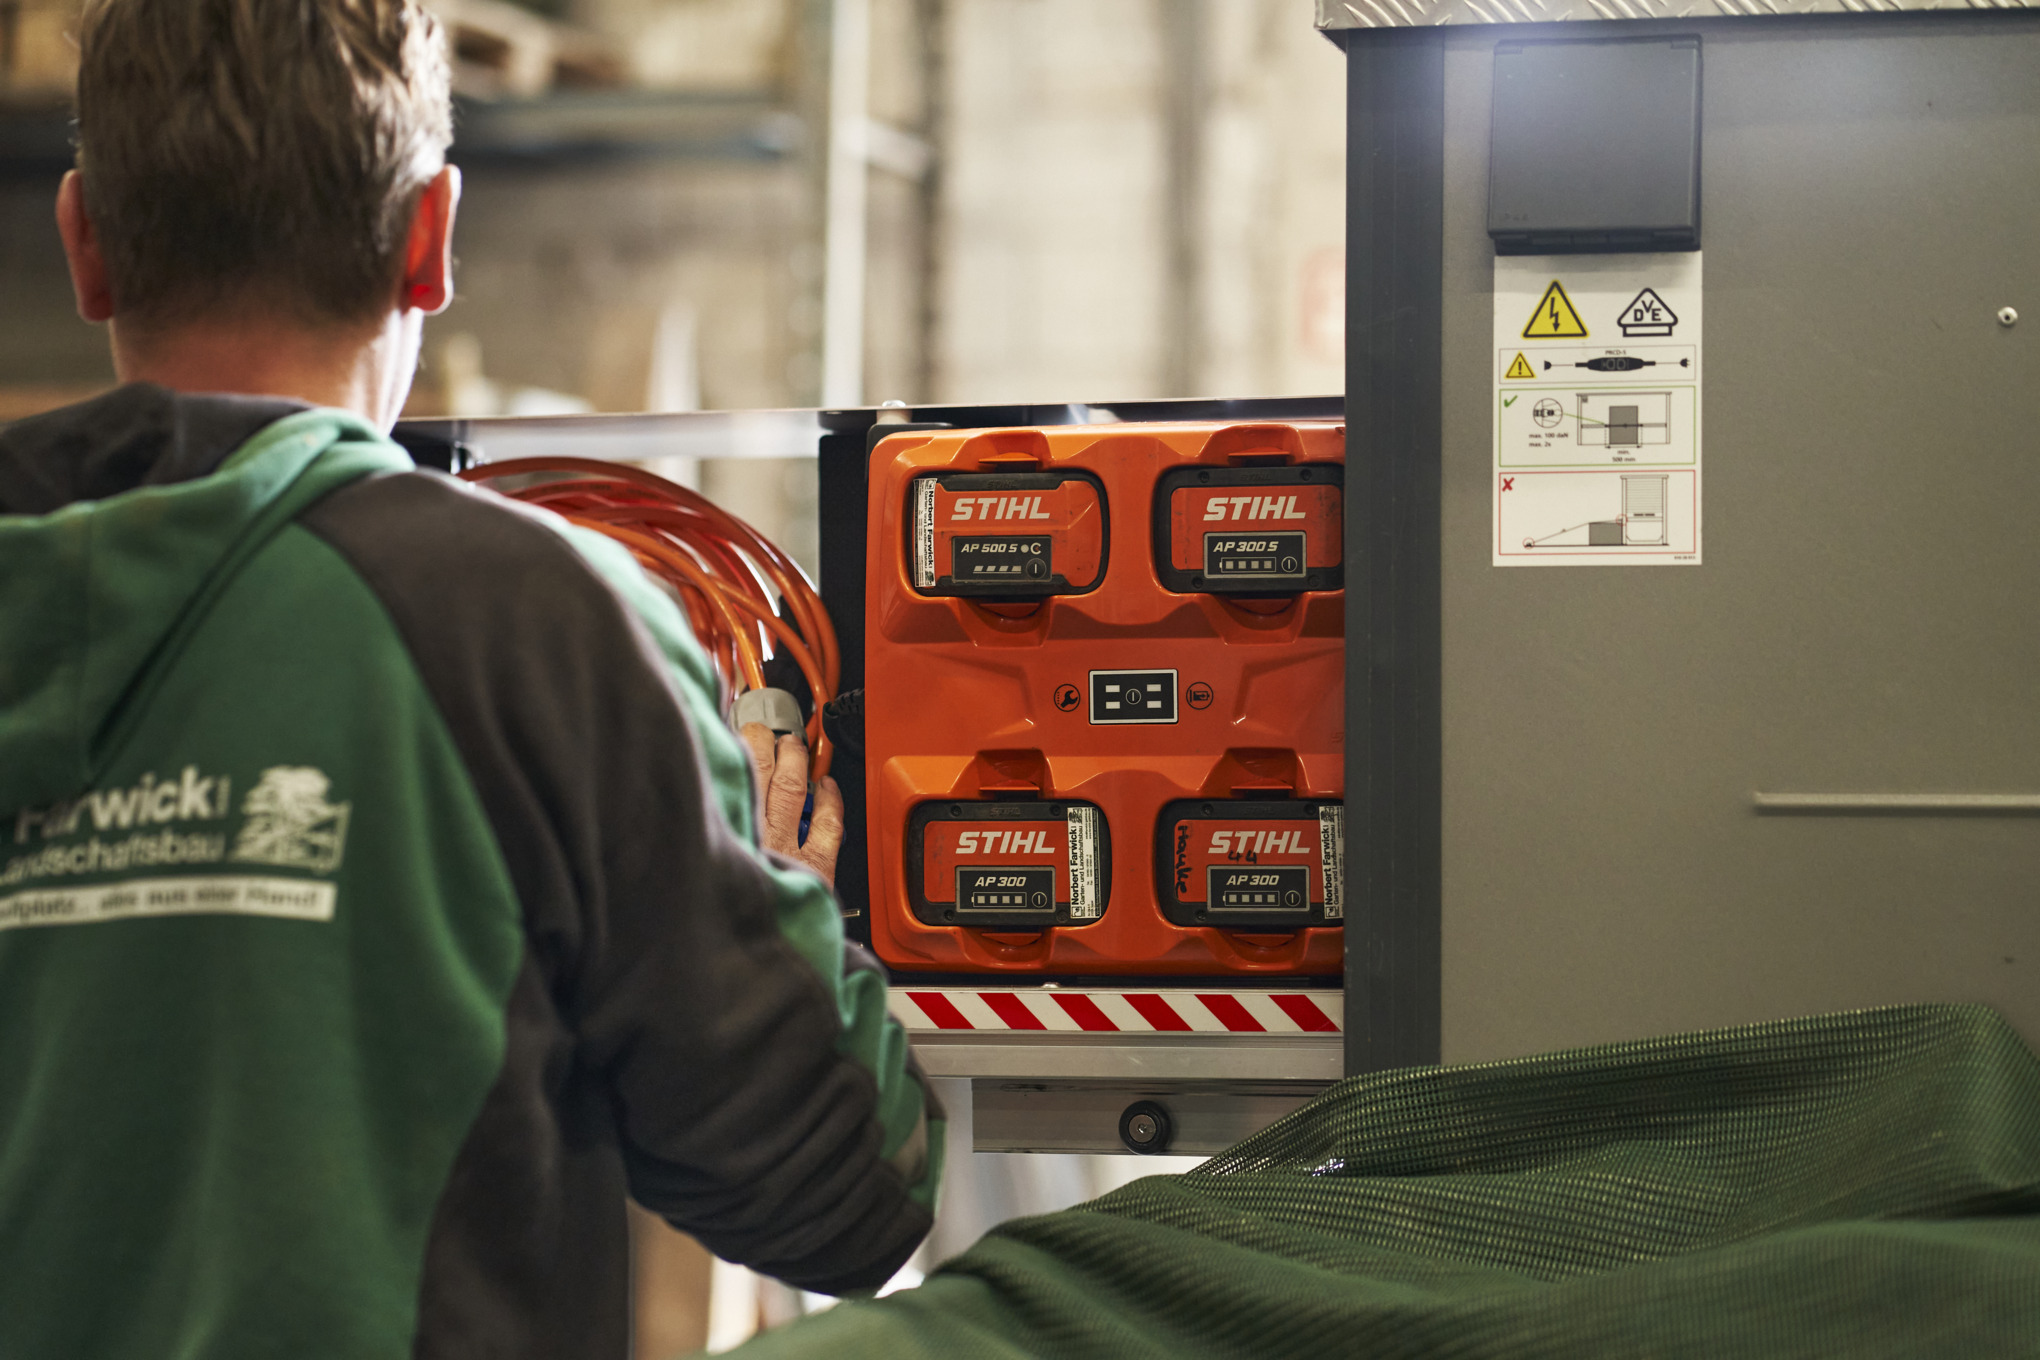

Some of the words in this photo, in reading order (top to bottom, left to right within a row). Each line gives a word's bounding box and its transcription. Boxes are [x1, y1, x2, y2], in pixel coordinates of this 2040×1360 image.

[927, 490, 935, 527] Norbert
[951, 496, 1051, 521] STIHL
[1203, 495, 1307, 521] STIHL
[927, 529, 935, 566] Farwick
[961, 543, 980, 553] AP
[981, 543, 1007, 553] 500
[1008, 543, 1019, 553] S
[1213, 541, 1235, 553] AP
[1236, 541, 1268, 552] 300
[1268, 541, 1279, 551] S
[955, 830, 1056, 854] STIHL
[1069, 828, 1078, 867] Farwick
[1207, 830, 1310, 854] STIHL
[1321, 827, 1331, 866] Farwick
[974, 876, 997, 887] AP
[997, 876, 1027, 887] 300
[1070, 868, 1080, 906] Norbert
[1226, 875, 1248, 886] AP
[1249, 875, 1280, 886] 300
[1324, 868, 1334, 906] Norbert
